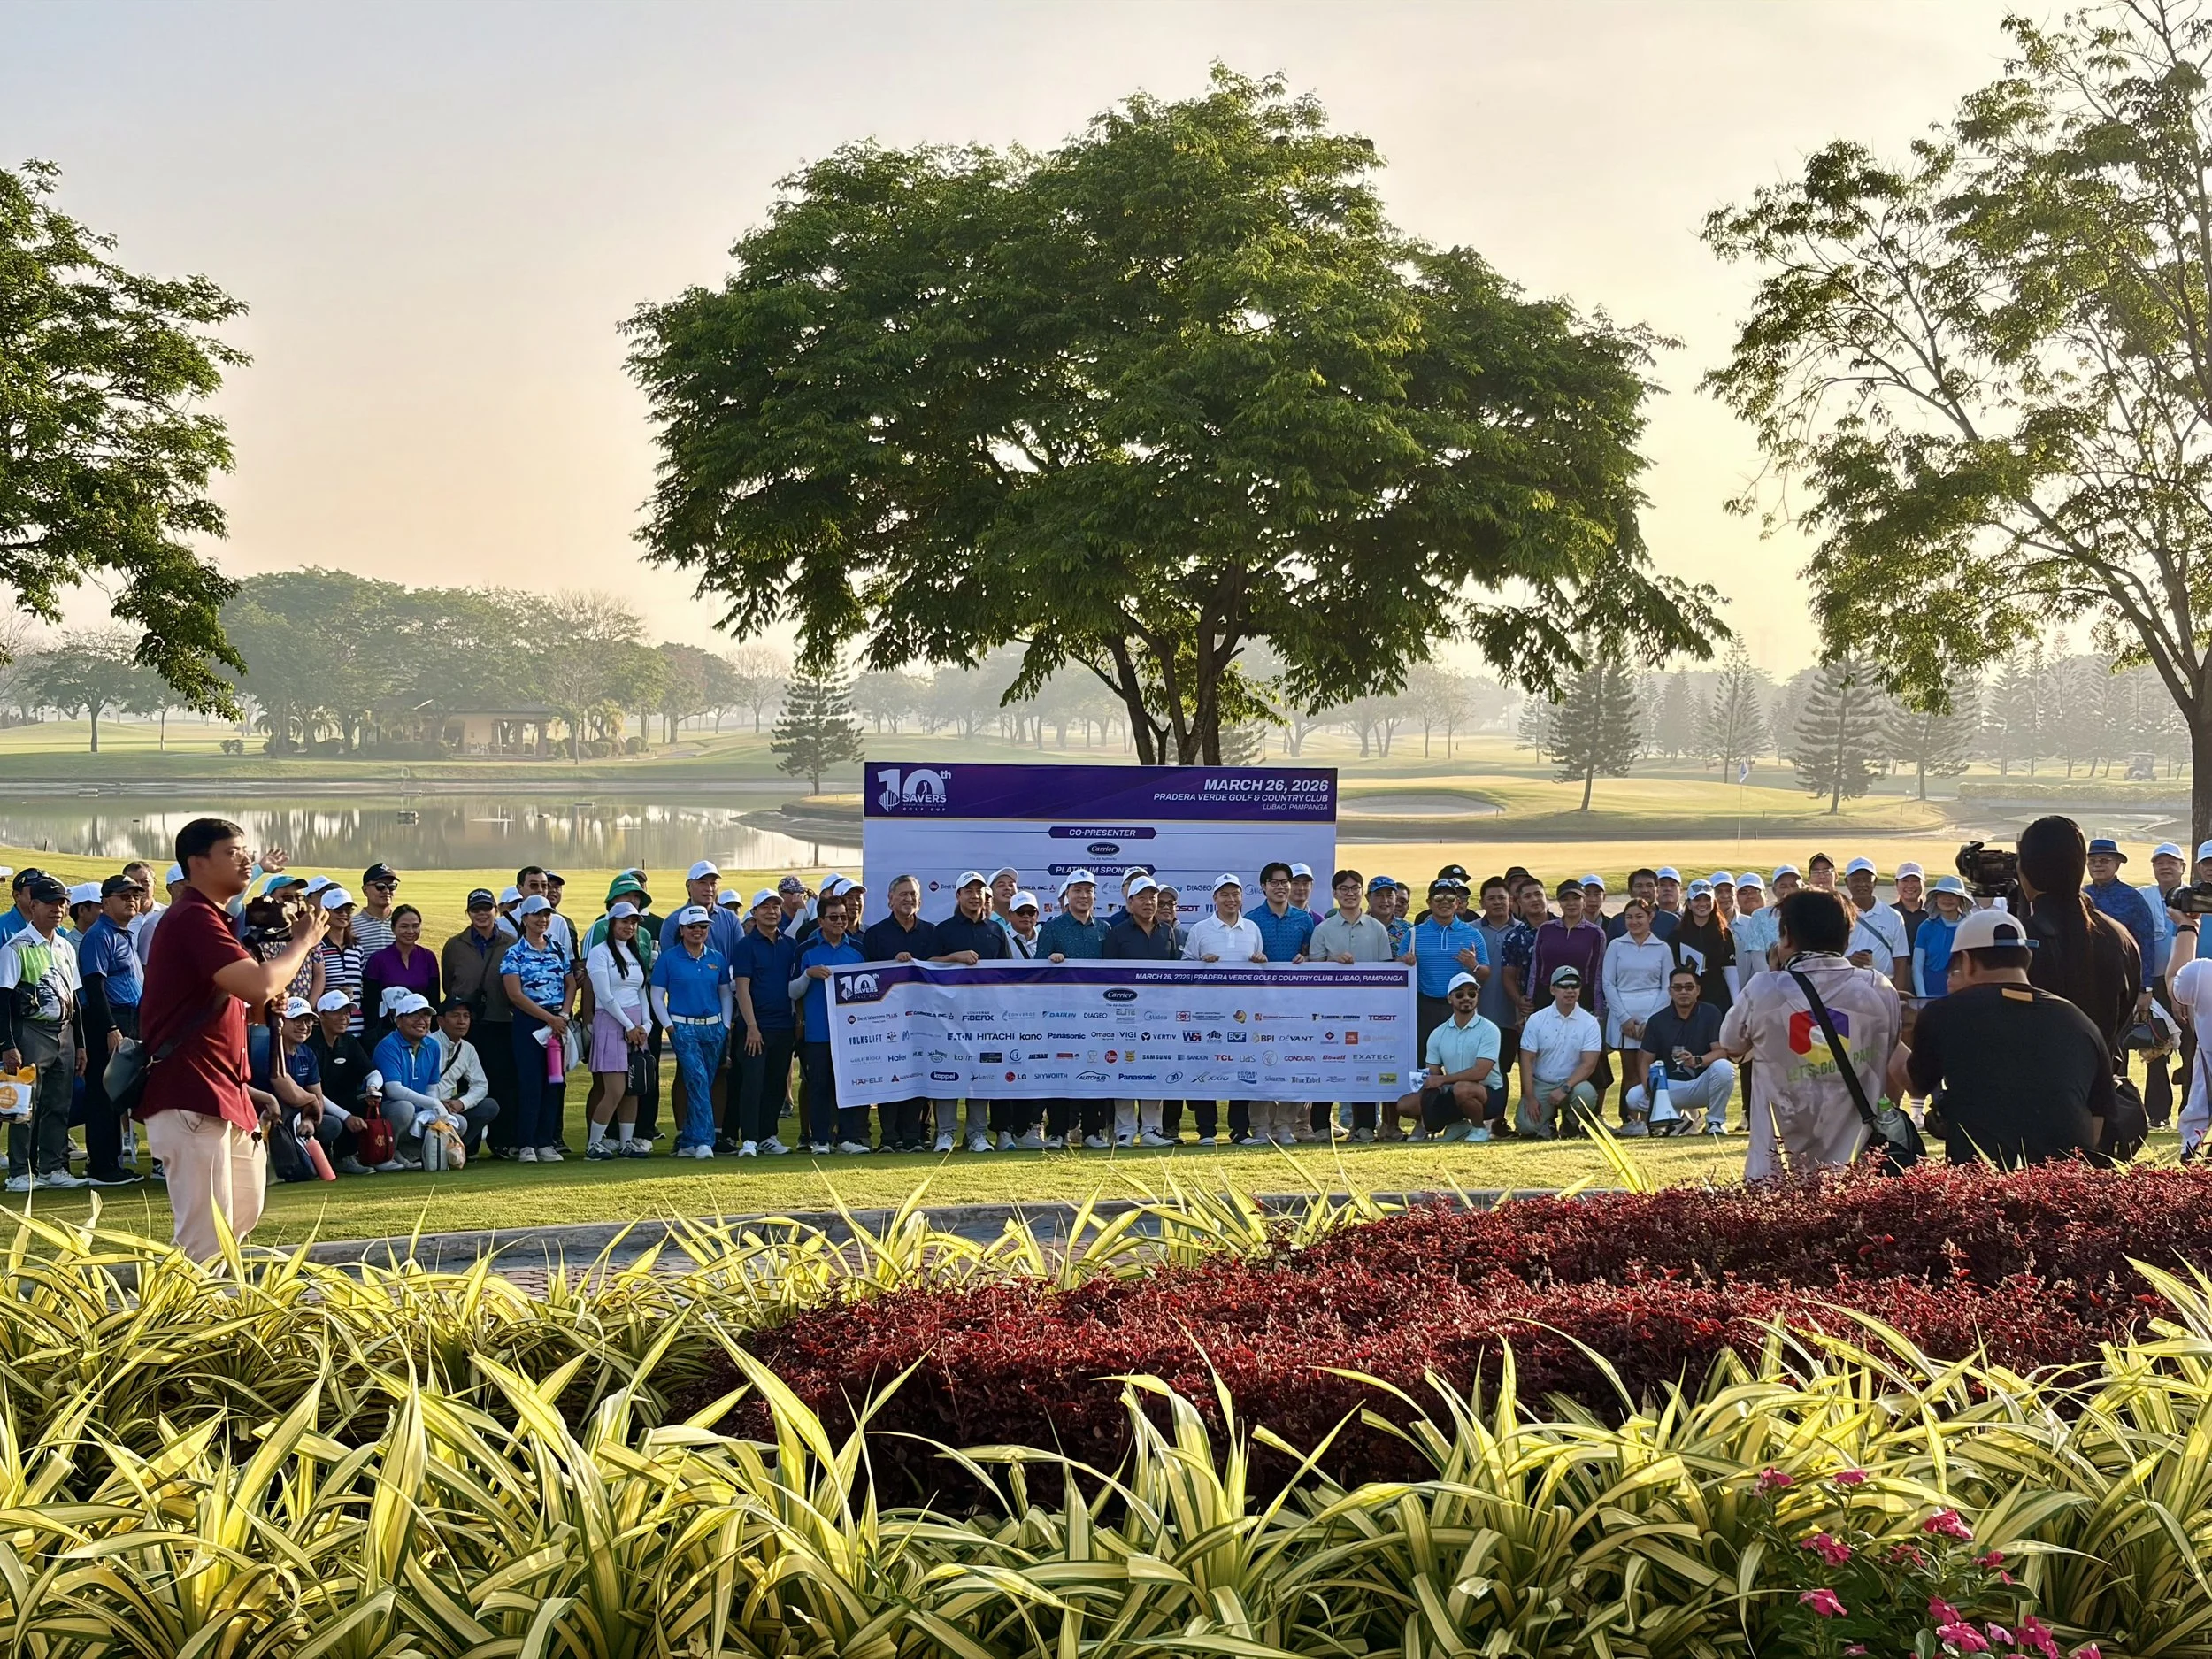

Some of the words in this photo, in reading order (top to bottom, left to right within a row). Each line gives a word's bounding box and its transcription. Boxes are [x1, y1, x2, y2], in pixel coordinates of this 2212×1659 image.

[1204, 779, 1264, 791] MARCH
[1265, 780, 1287, 794] 26,
[1292, 780, 1329, 792] 2026
[902, 794, 946, 803] SAVERS
[849, 1034, 882, 1045] VOLKSLIFT
[1019, 1032, 1042, 1041] kano
[887, 1054, 907, 1063] Haier
